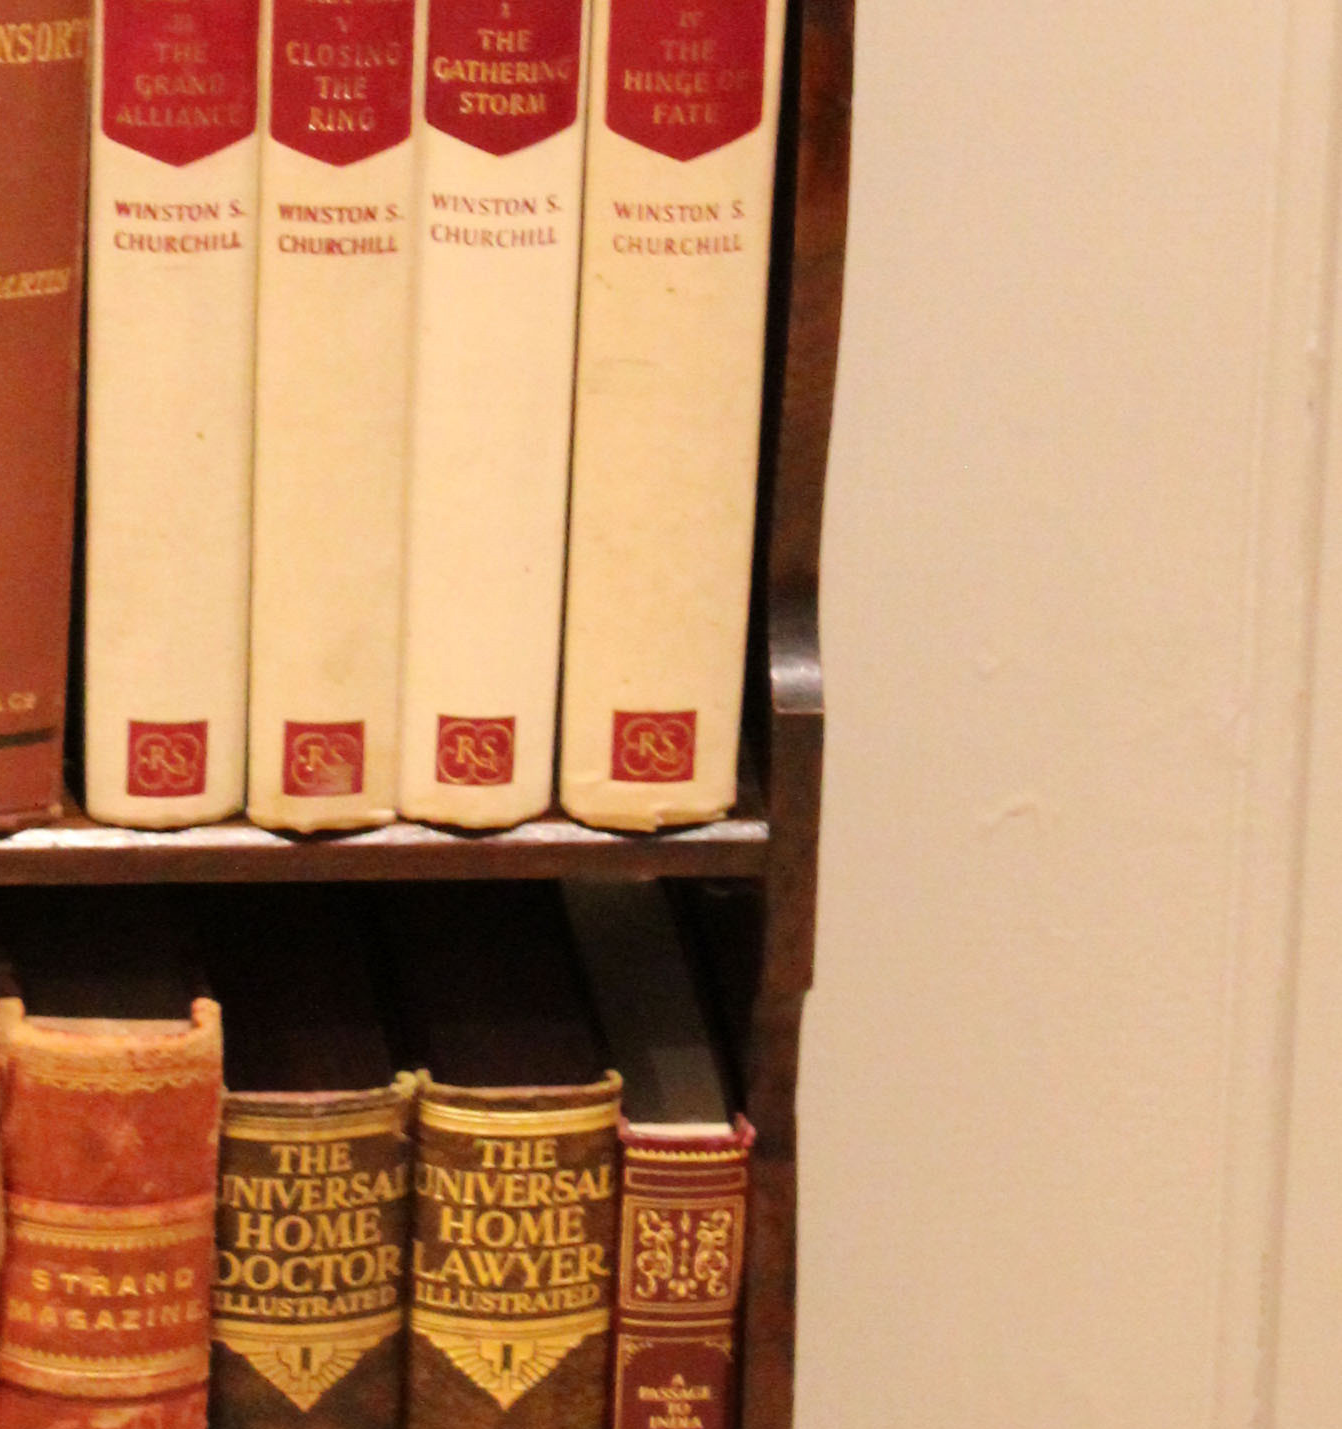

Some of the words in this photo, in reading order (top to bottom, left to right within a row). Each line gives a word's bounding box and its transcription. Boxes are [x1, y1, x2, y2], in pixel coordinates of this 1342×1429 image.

[477, 29, 534, 52] THE
[661, 40, 716, 62] THE
[154, 42, 206, 64] THE
[286, 42, 402, 68] CLOSING
[433, 57, 571, 84] GATHERING
[624, 70, 707, 93] HINGE
[135, 74, 224, 100] GRAND
[316, 77, 367, 100] THE
[459, 93, 547, 116] STORM
[653, 104, 716, 125] FATE
[117, 106, 248, 127] ALLIANCE
[308, 107, 376, 131] RING
[114, 200, 218, 222] WINSTON
[278, 204, 378, 224] WINSTON
[432, 194, 537, 216] WINSTON
[613, 200, 719, 223] WINSTON
[114, 231, 242, 253] CHURCHILL
[278, 234, 398, 256] CHURCHILL
[431, 224, 557, 248] CHURCHILL
[612, 234, 743, 256] CHURCHILL
[271, 1143, 351, 1174] THE
[478, 1138, 557, 1169] THE
[235, 1208, 381, 1252] HOME
[439, 1206, 585, 1248] HOME
[217, 1245, 402, 1292] DOCTOR
[413, 1238, 609, 1287] LAWYER
[32, 1268, 195, 1298] STRAND
[416, 1281, 600, 1313] ILLUSTRATED
[9, 1299, 205, 1331] MAGAZINE
[672, 1373, 684, 1387] A
[668, 1403, 691, 1416] TO
[649, 1416, 703, 1429] INDIA
